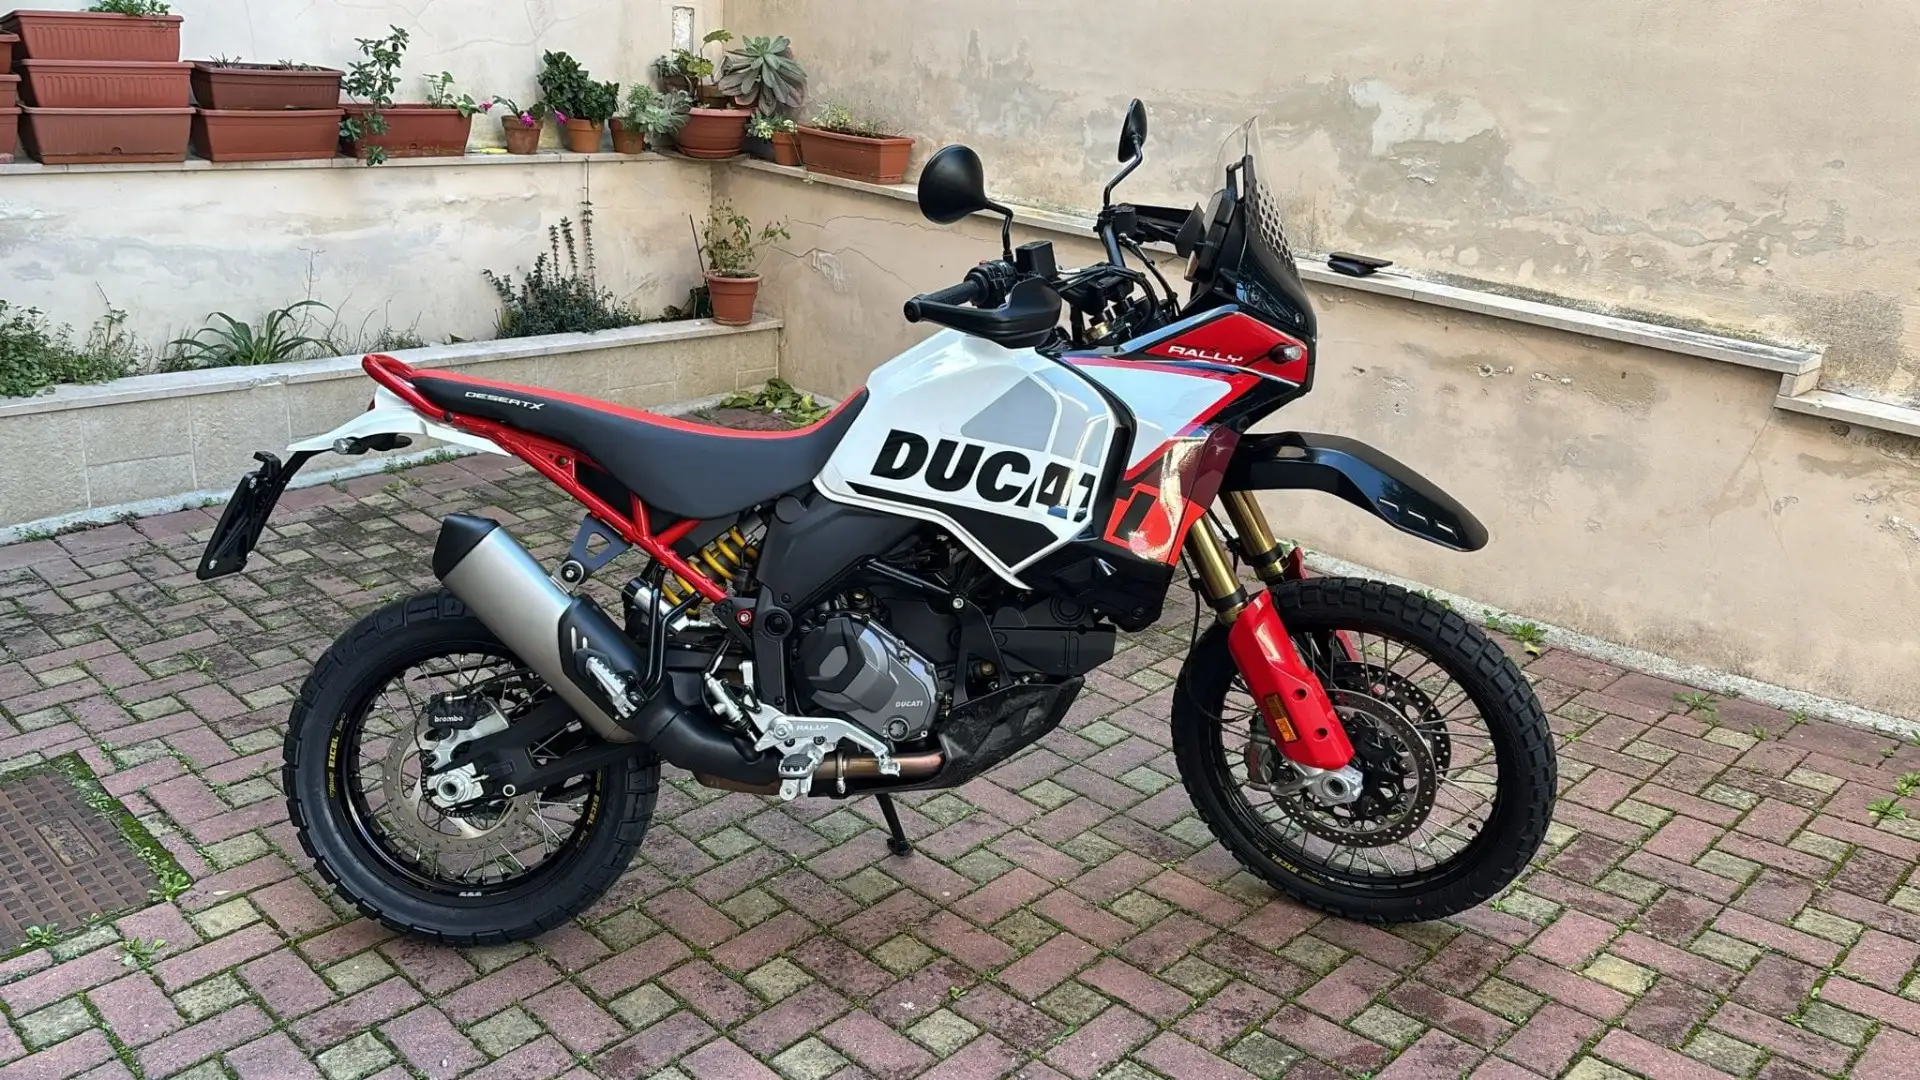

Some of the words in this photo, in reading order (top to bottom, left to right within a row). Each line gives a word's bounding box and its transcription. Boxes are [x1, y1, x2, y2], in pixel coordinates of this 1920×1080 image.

[1168, 345, 1244, 363] RALLY
[464, 391, 546, 410] DESERTX
[895, 700, 924, 708] DUCATI
[434, 715, 464, 723] brembo
[796, 724, 829, 732] RALLY
[328, 736, 339, 768] EXCEL
